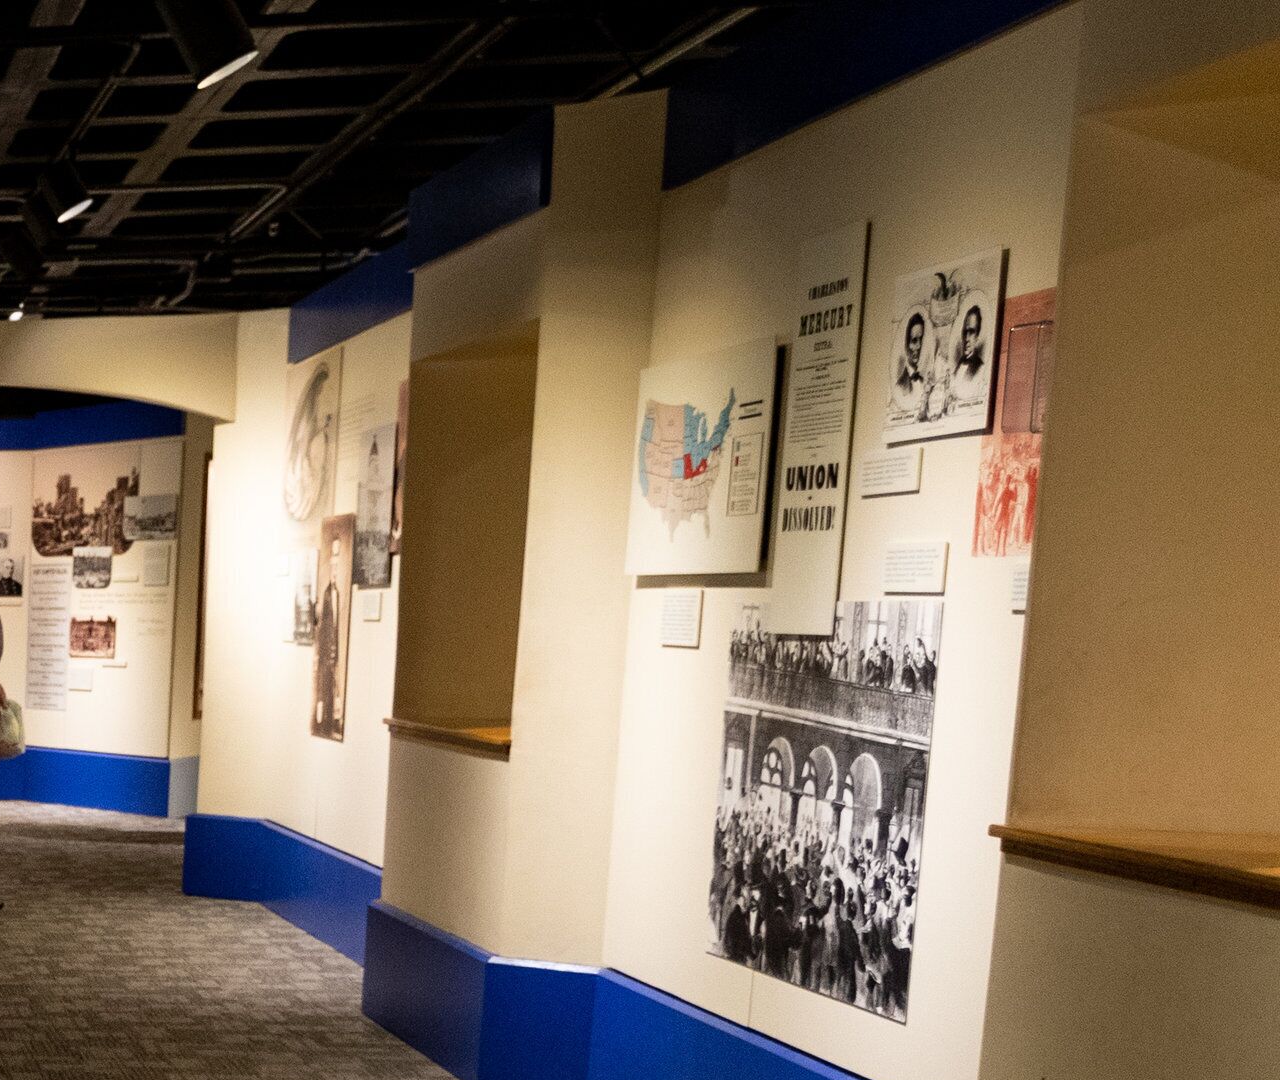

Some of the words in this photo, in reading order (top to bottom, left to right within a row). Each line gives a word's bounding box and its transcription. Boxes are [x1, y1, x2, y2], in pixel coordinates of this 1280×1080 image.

[808, 278, 848, 300] CHARLESTON
[798, 304, 852, 338] MERCURY
[786, 463, 839, 491] UNION
[782, 506, 836, 532] DISSOLVED!
